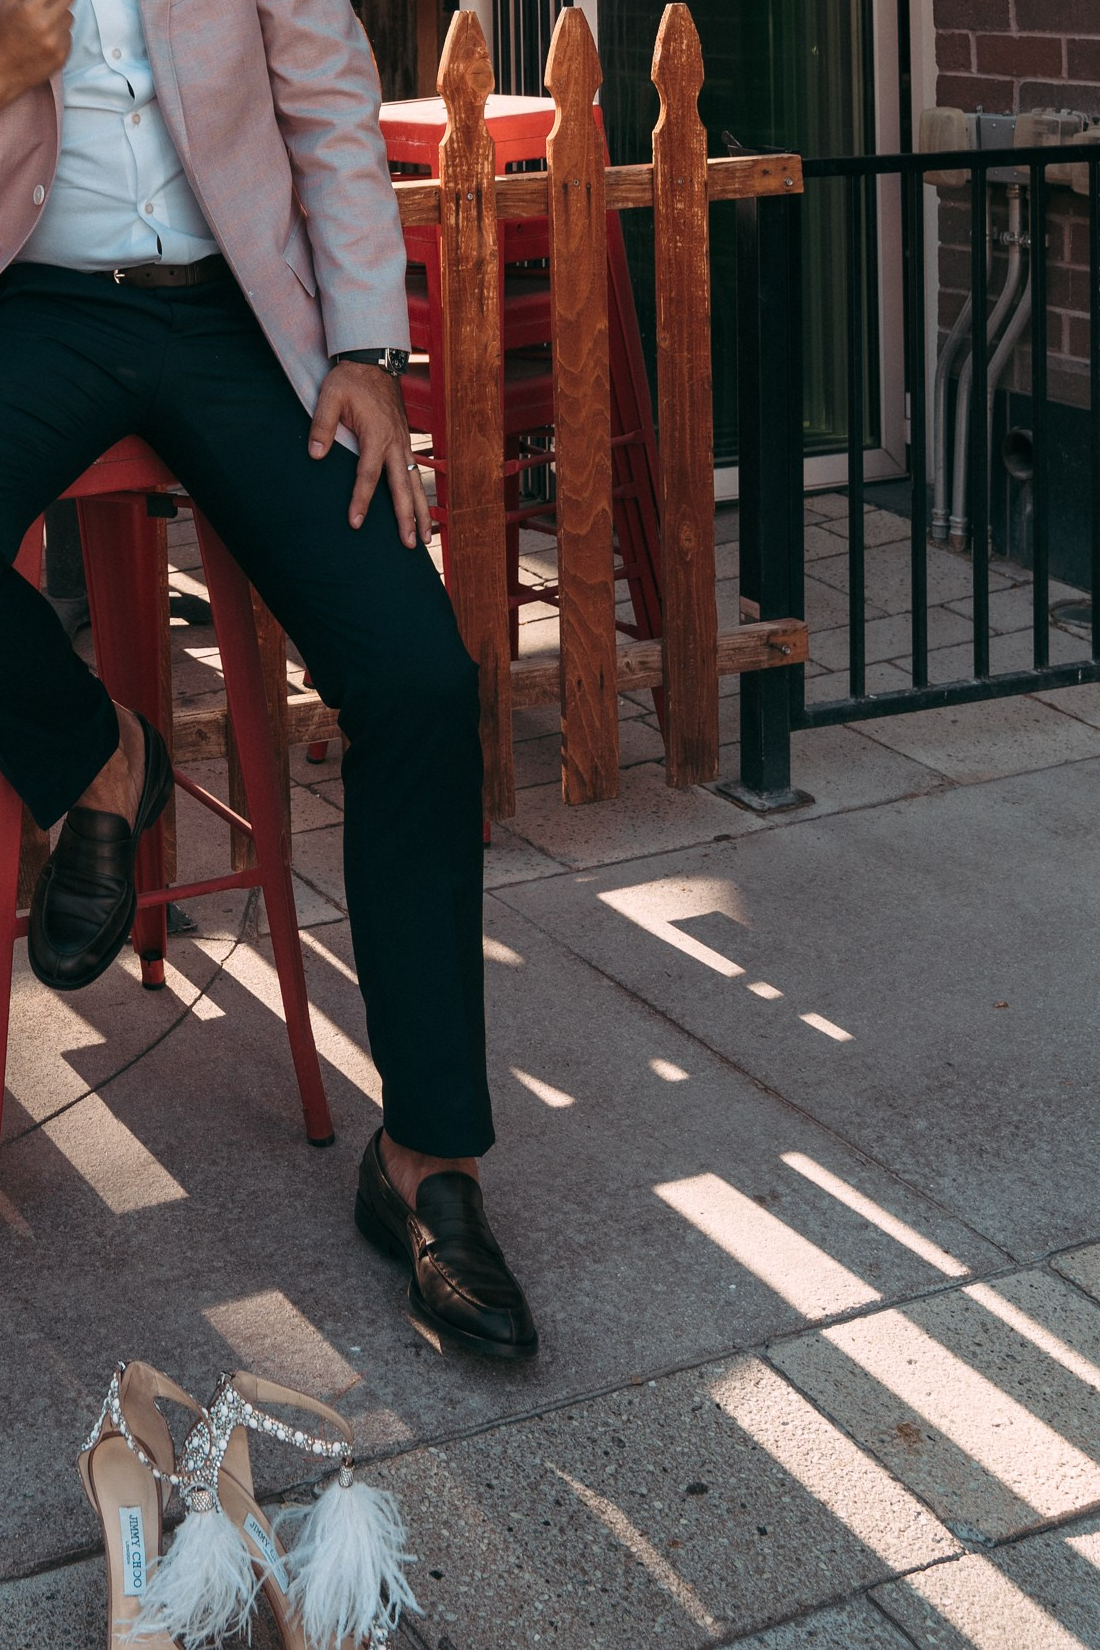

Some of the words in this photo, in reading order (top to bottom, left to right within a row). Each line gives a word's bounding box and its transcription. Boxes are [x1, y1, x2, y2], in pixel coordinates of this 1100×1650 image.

[129, 1514, 140, 1548] JIMMY
[249, 1521, 270, 1547] JIMMY
[132, 1551, 142, 1588] CHOO
